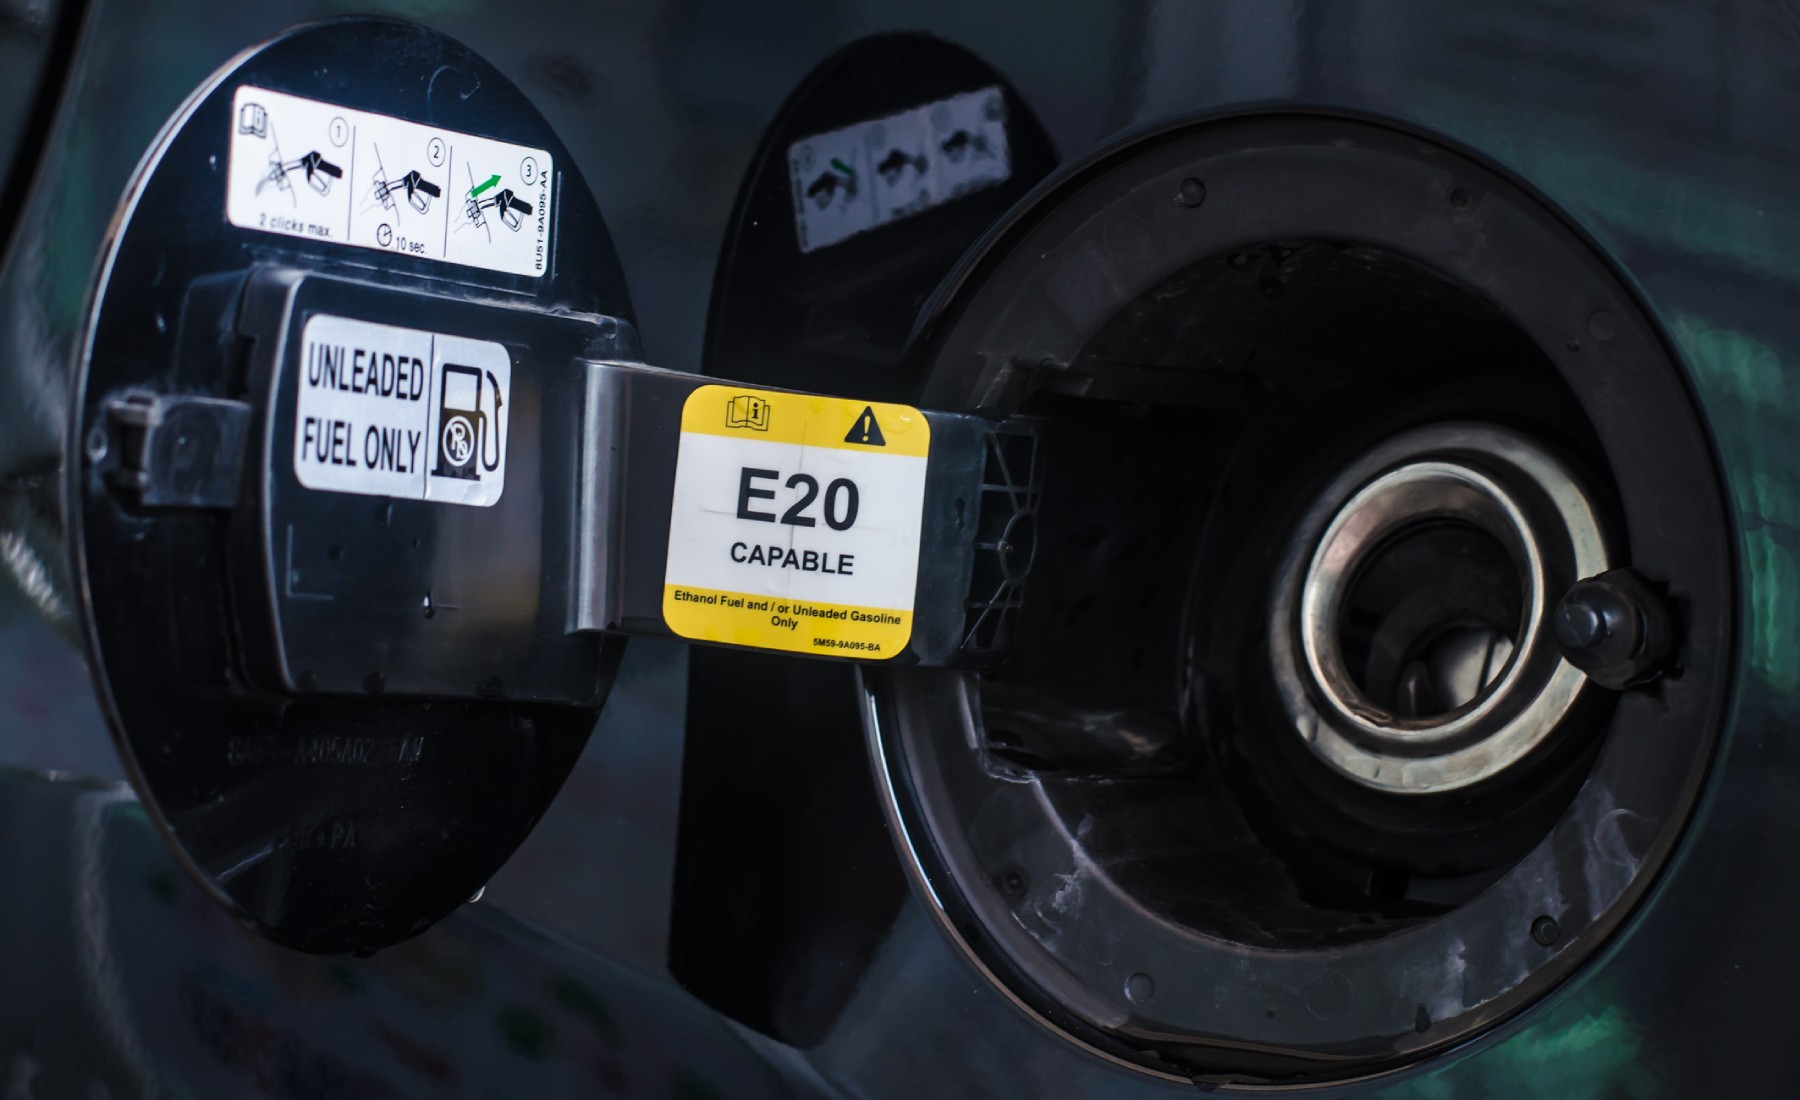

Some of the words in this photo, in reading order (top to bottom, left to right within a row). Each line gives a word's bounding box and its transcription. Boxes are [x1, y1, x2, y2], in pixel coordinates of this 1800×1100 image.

[336, 125, 341, 139] 1
[432, 145, 440, 159] 2
[525, 164, 532, 177] 3
[260, 214, 266, 227] 2
[269, 215, 304, 234] clicks
[308, 223, 333, 238] max.
[396, 237, 406, 250] 10
[409, 241, 428, 254] sec.
[308, 341, 424, 401] UNLEADED
[302, 417, 357, 465] FUEL
[364, 425, 421, 474] ONLY
[736, 467, 859, 531] E20
[730, 542, 855, 575] CAPABLE
[674, 590, 717, 605] Ethanol
[720, 596, 744, 609] Fuel
[747, 600, 768, 611] and
[778, 604, 790, 612] or
[793, 605, 847, 620] Unleaded
[851, 611, 901, 625] Gasoline
[771, 616, 798, 630] Only
